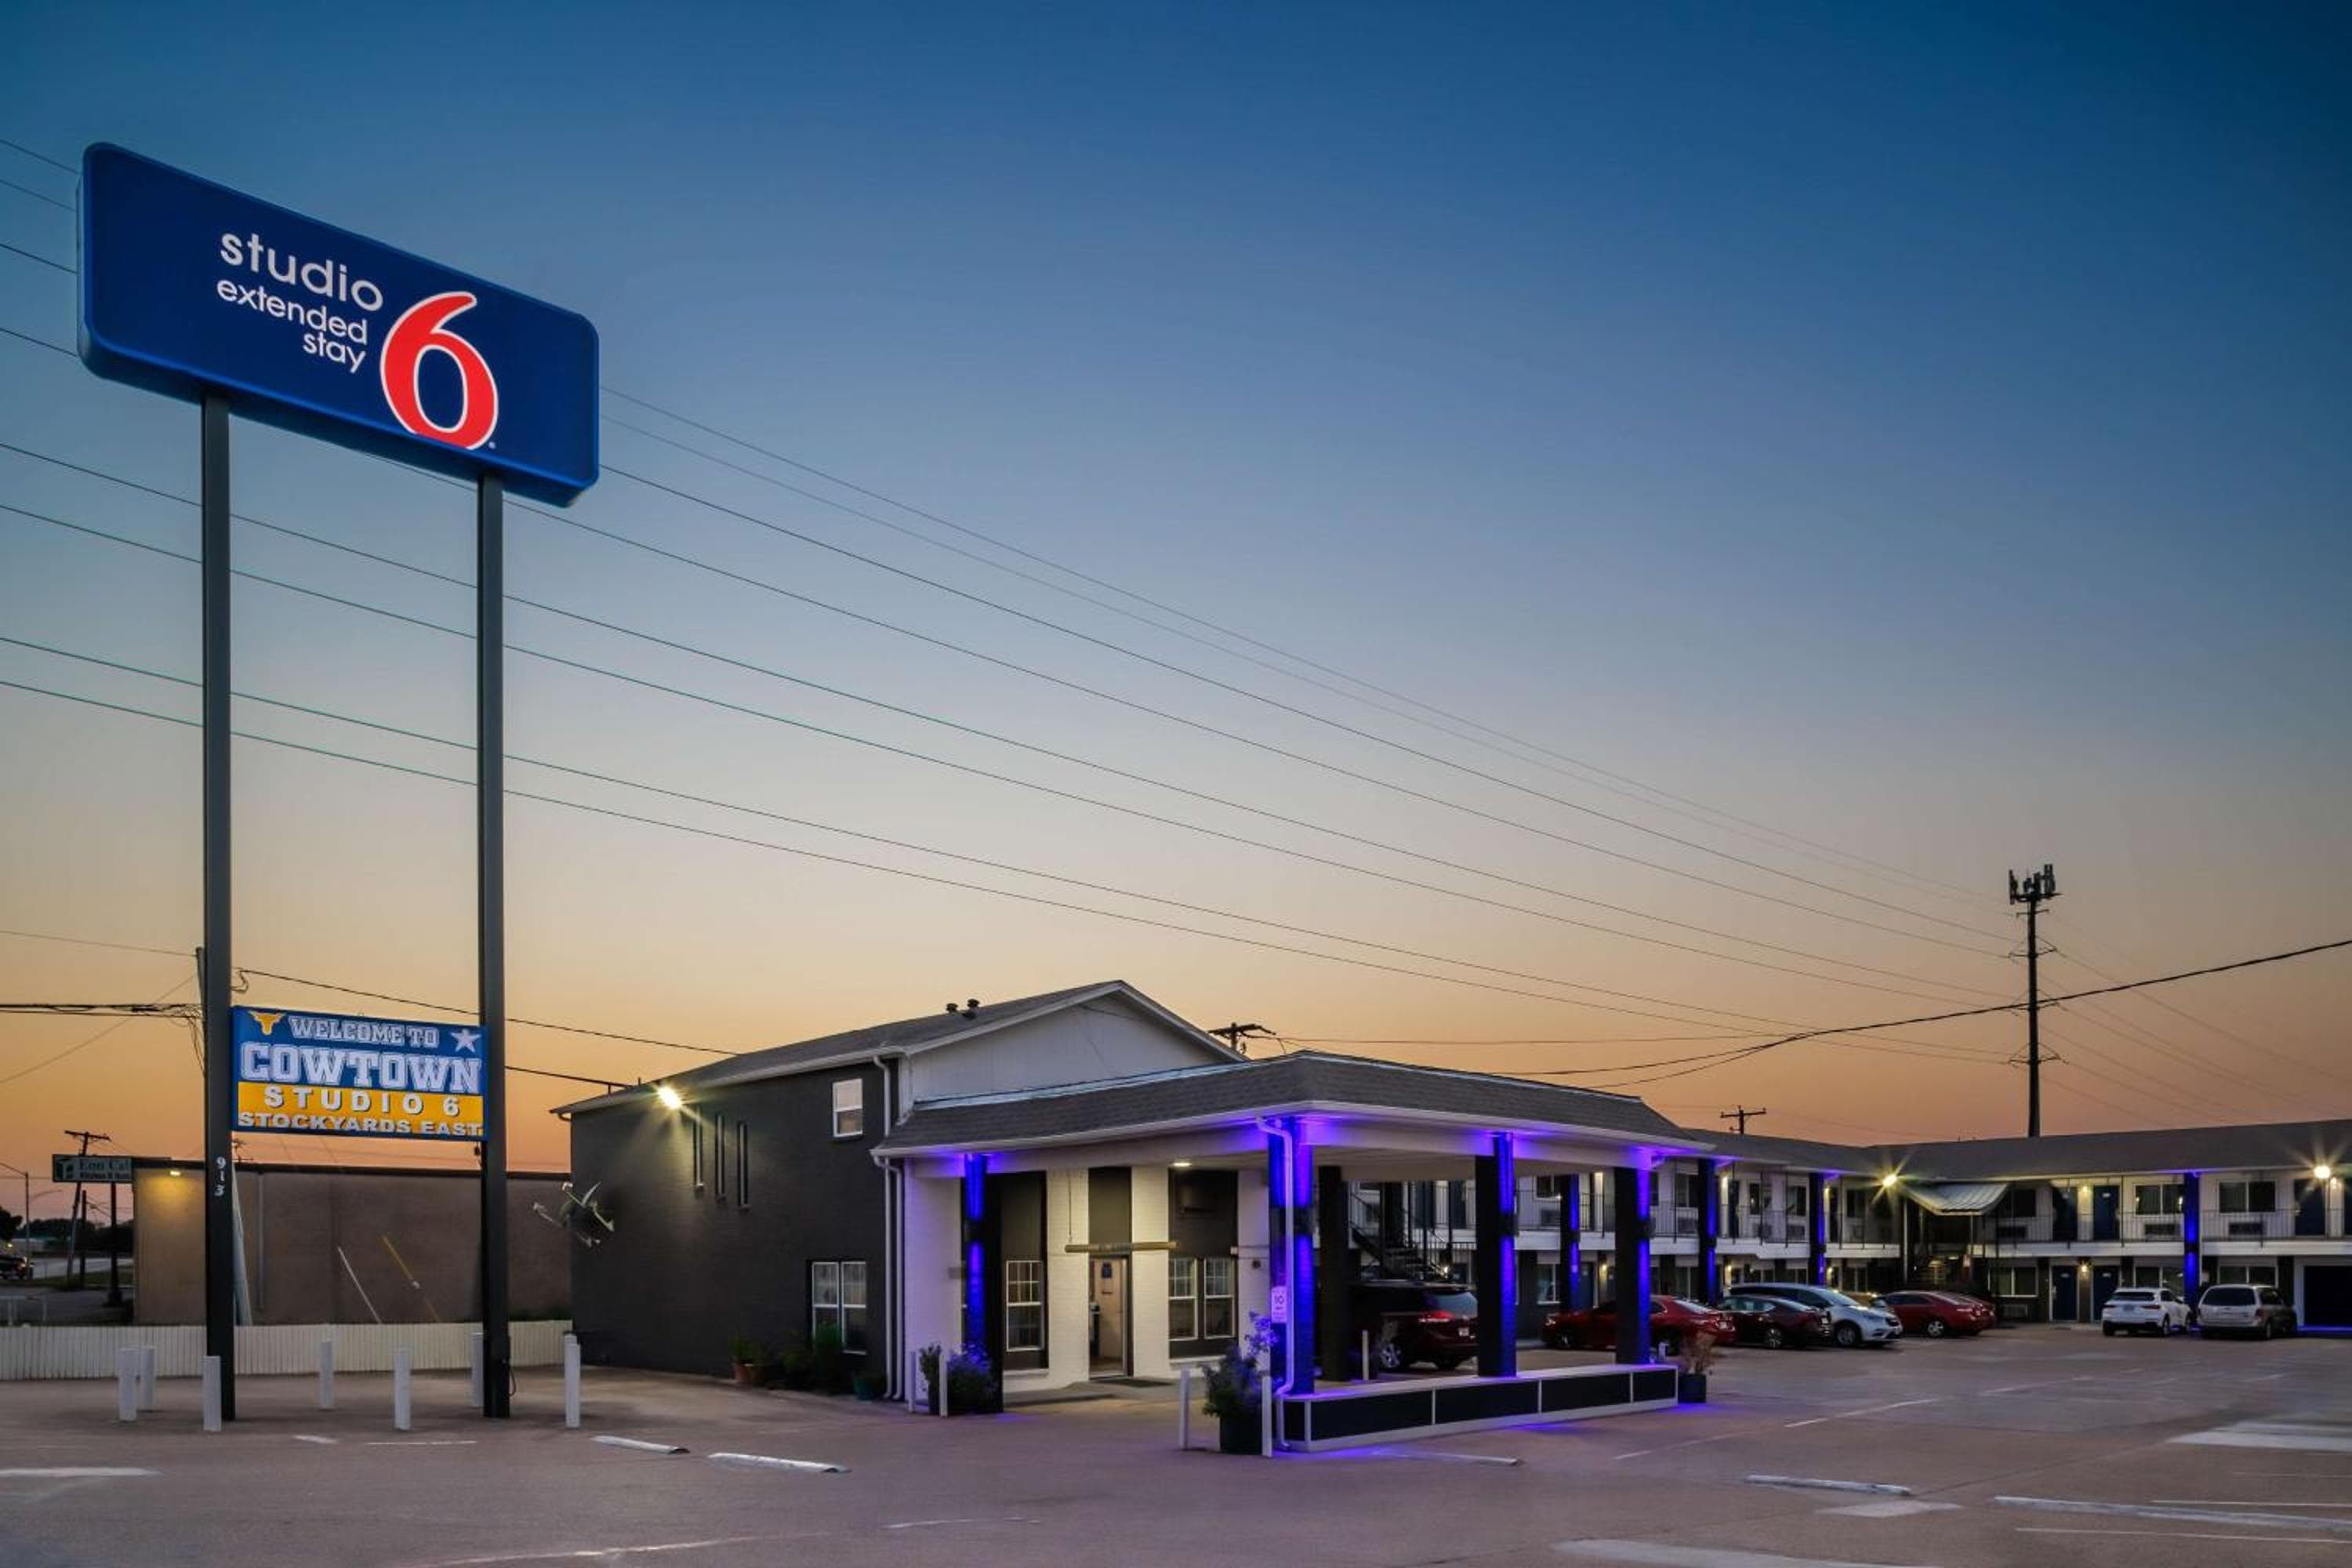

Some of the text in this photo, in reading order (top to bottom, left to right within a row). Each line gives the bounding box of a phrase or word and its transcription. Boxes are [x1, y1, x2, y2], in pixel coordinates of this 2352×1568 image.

[220, 233, 383, 311] studio
[217, 280, 367, 345] extended
[303, 332, 366, 374] stay
[379, 291, 499, 450] 6
[288, 1015, 440, 1048] WELCOME TO
[241, 1041, 482, 1094] COWTOWN
[238, 1112, 483, 1137] STOCKYARDS EAST
[264, 1085, 460, 1117] STUDIO 6
